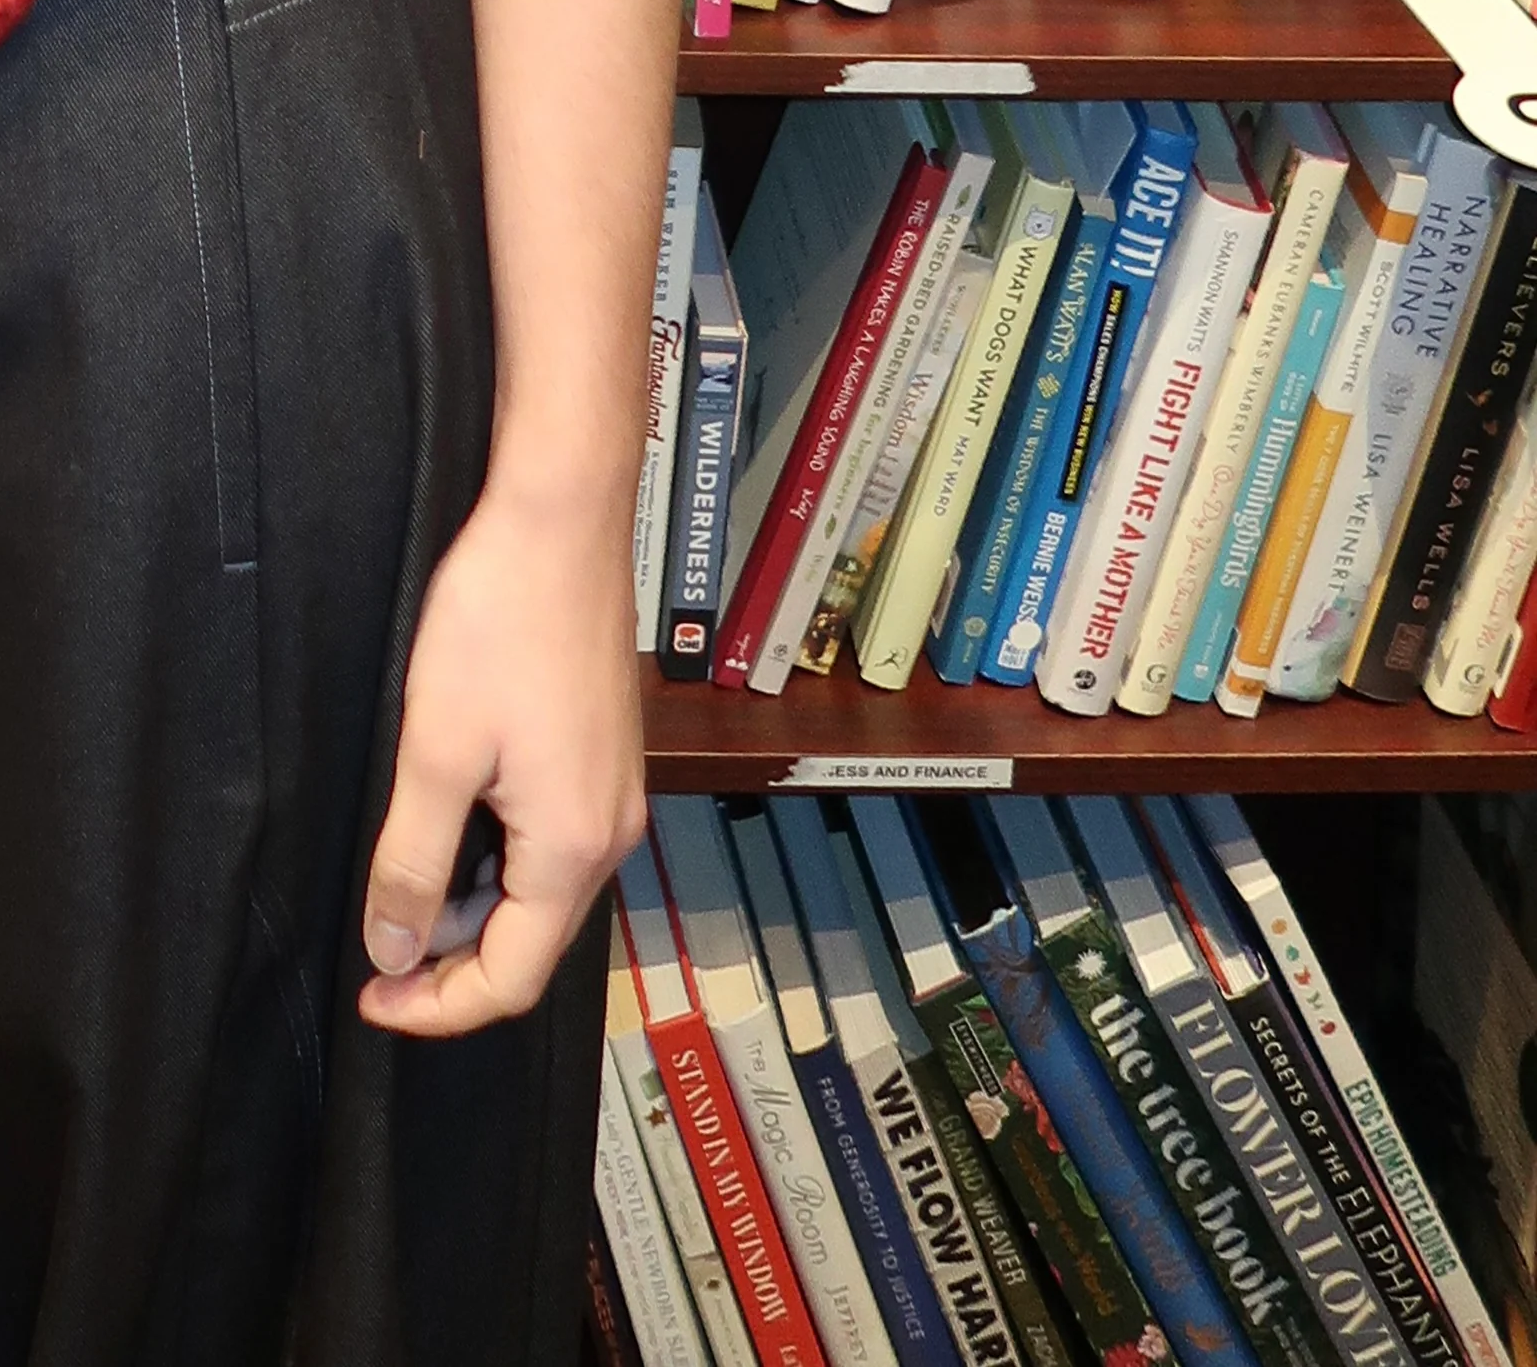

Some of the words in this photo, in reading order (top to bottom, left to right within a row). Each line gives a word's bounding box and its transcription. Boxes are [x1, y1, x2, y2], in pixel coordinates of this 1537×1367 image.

[1002, 245, 1039, 307] WHAT
[984, 305, 1017, 366] DOGS
[963, 370, 997, 428] WANT
[1149, 359, 1203, 453] FIGHT
[682, 420, 724, 605] WILDERNESS
[1124, 453, 1171, 523] LIKE
[1117, 520, 1147, 542] A
[1079, 545, 1141, 662] MOTHER
[873, 765, 909, 779] AND
[913, 765, 988, 780] FINANCE
[671, 1048, 723, 1137] STAND
[701, 1137, 733, 1176] IN
[712, 1167, 749, 1210] MY
[872, 1069, 926, 1150] WE
[899, 1150, 976, 1274] FLOW
[1089, 992, 1156, 1085] the
[1137, 1082, 1215, 1193] tree
[1194, 1185, 1290, 1327] book
[729, 1210, 790, 1325] WINDOW
